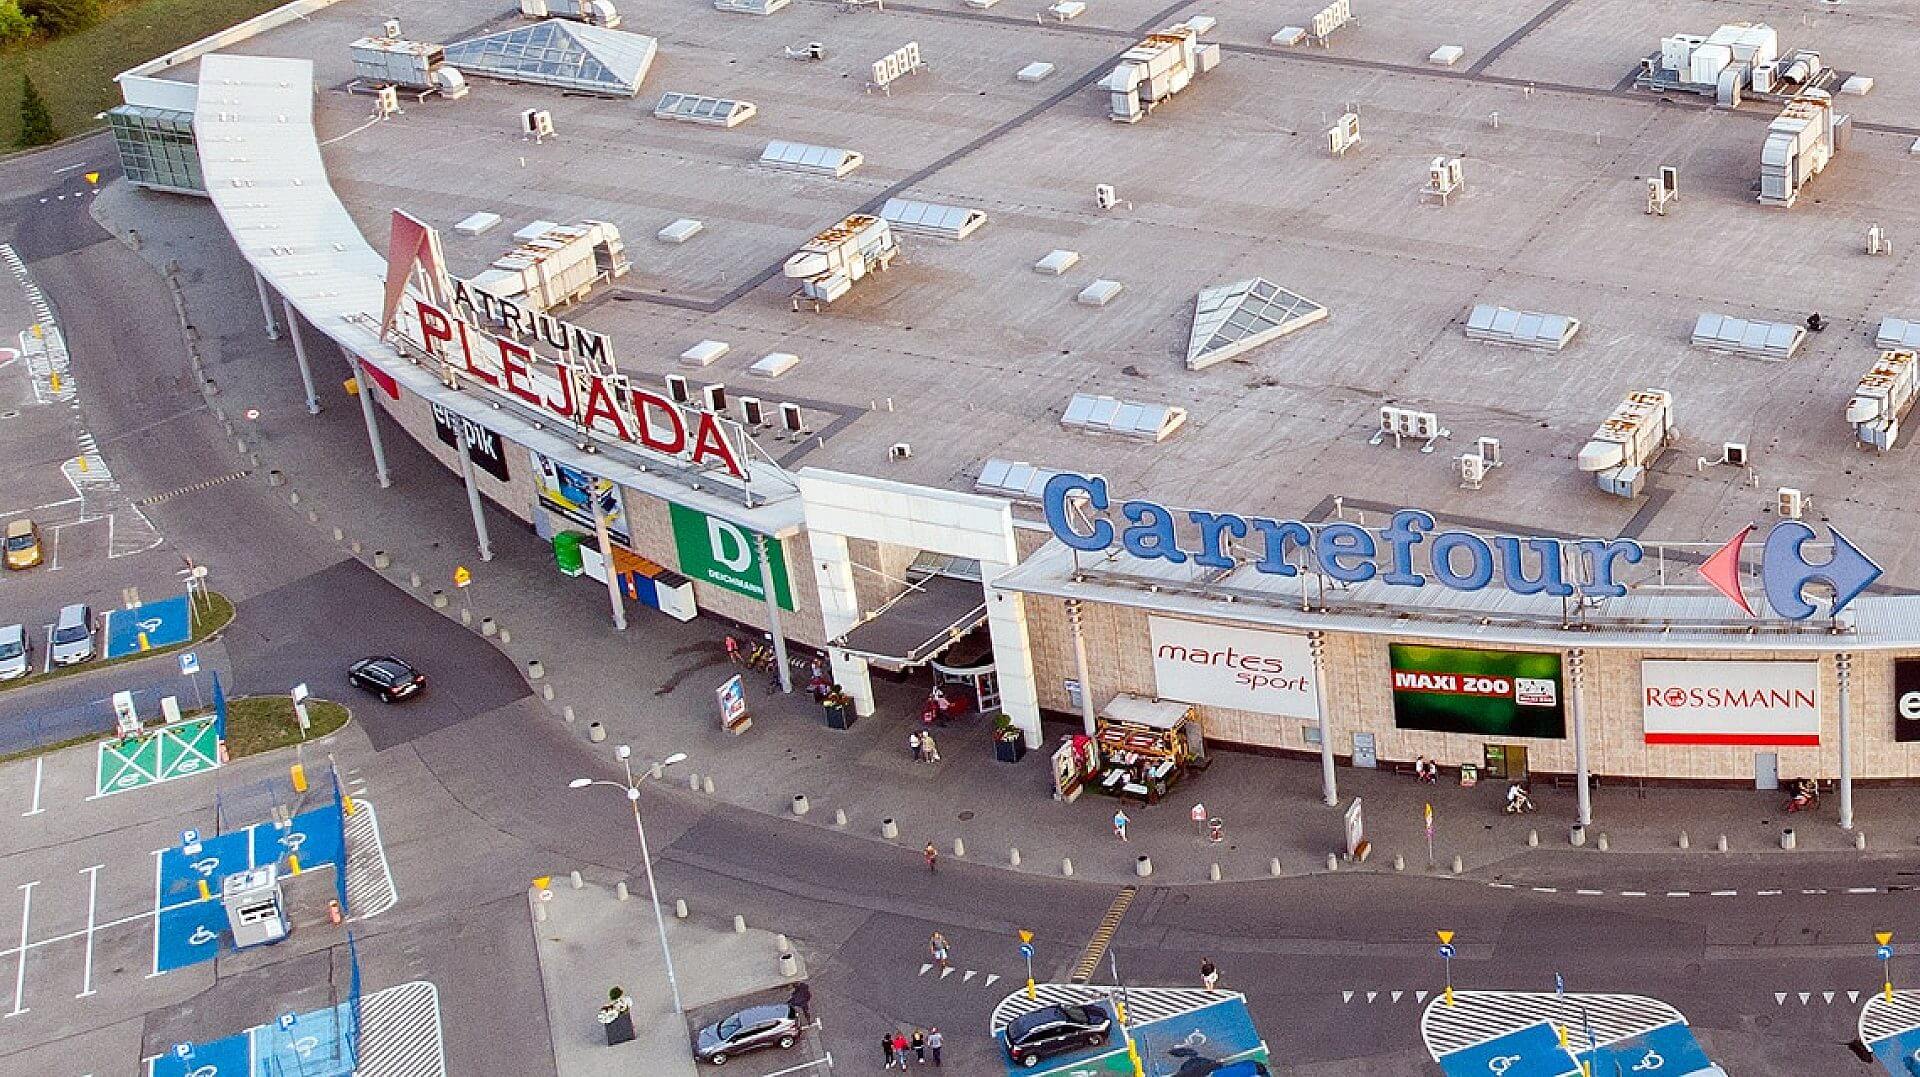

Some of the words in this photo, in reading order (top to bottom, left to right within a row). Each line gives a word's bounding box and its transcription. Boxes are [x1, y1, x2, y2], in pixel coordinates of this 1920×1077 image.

[454, 280, 609, 366] ATRIUM
[416, 301, 744, 480] PLEJADA
[706, 515, 752, 570] D
[1043, 473, 1643, 598] Carrefour
[1157, 642, 1283, 673] martes
[1235, 671, 1310, 693] sport
[1395, 672, 1457, 691] MAXI
[1463, 677, 1510, 694] ZOO
[1646, 687, 1816, 710] ROSSMANN
